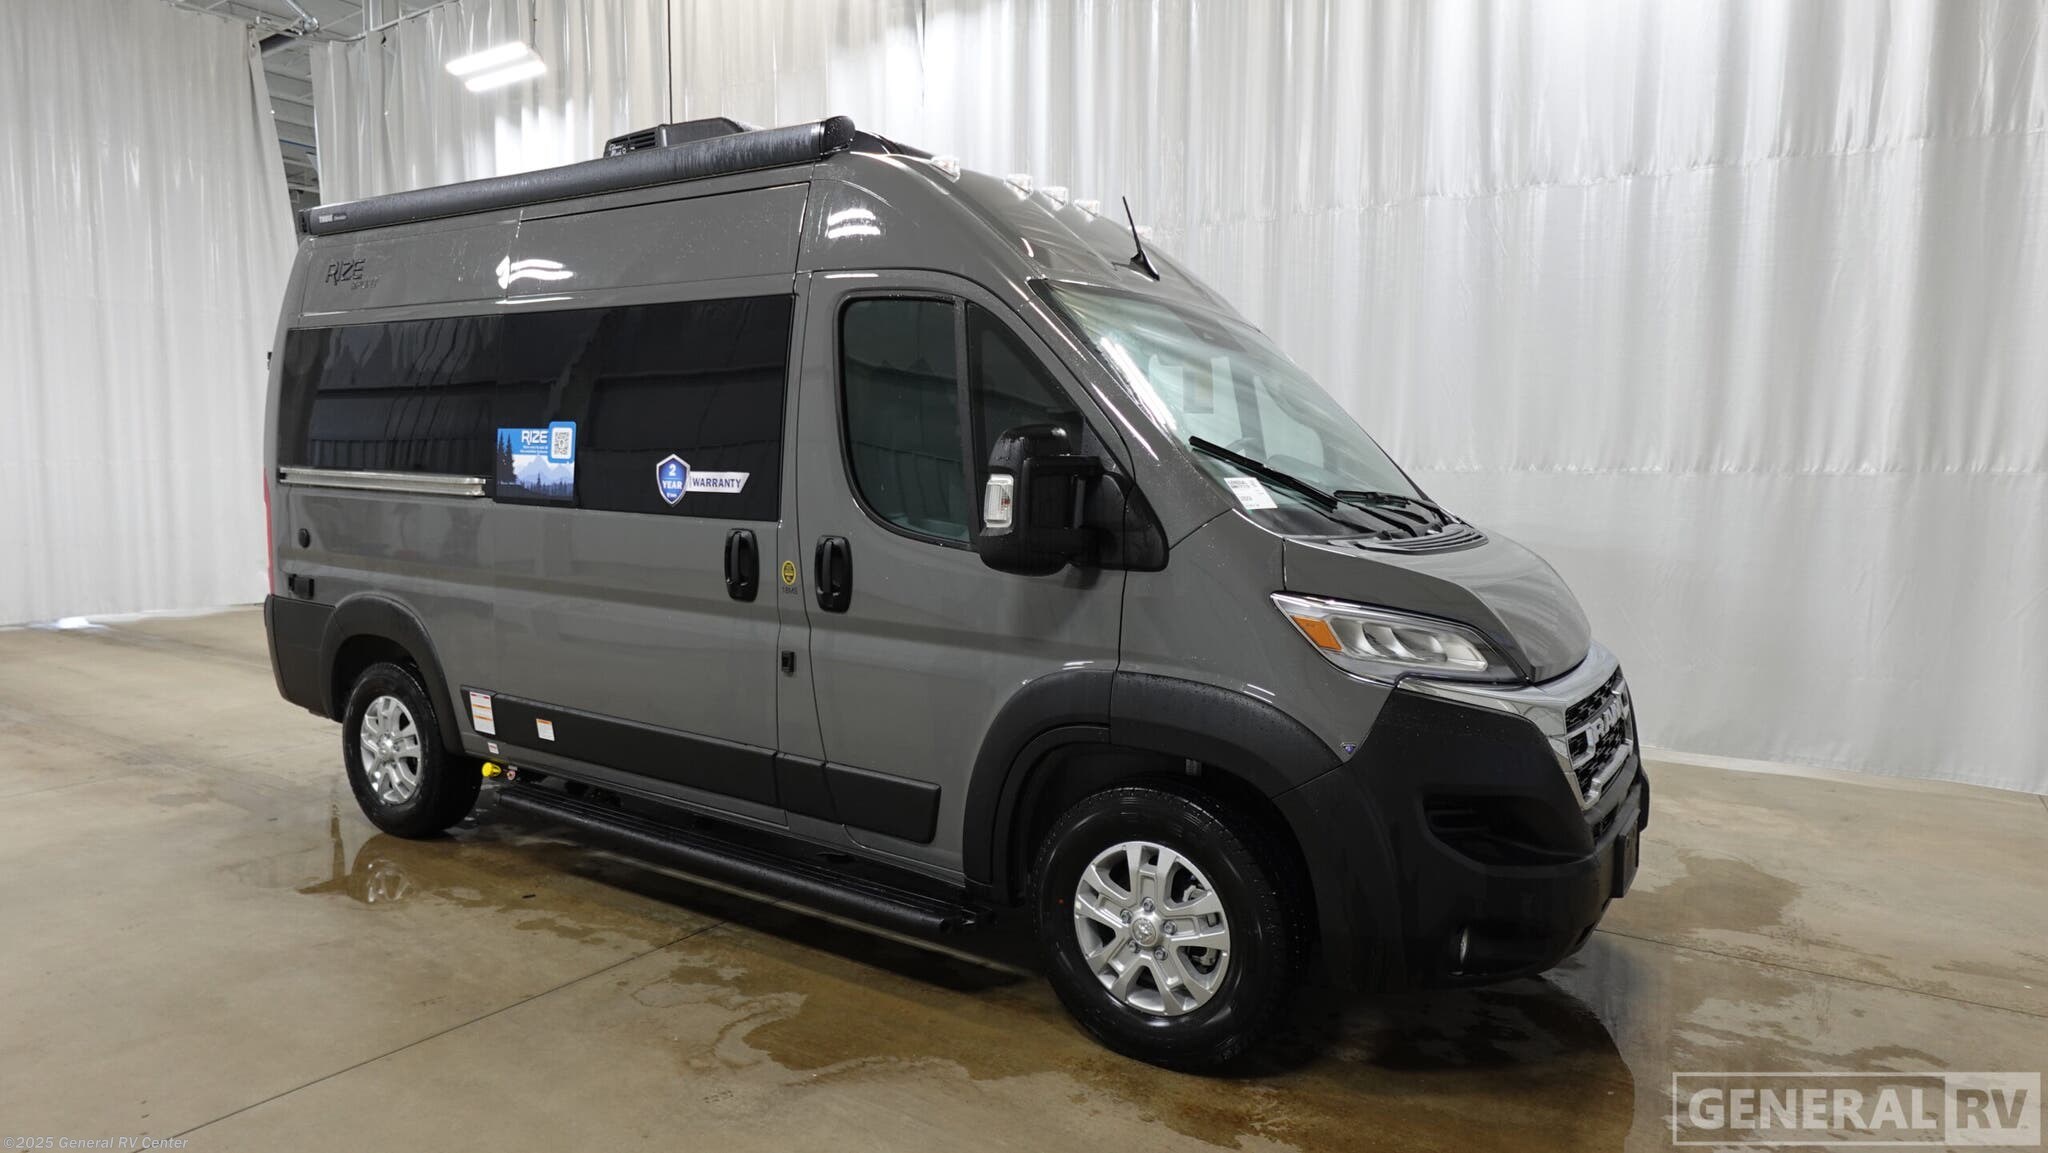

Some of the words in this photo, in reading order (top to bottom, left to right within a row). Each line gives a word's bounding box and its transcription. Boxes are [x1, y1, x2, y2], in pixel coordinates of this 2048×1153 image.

[325, 258, 366, 286] RIZE
[521, 430, 549, 445] RIZE
[668, 463, 677, 477] 2
[662, 480, 683, 490] YEAR
[692, 478, 742, 489] WARRANTY
